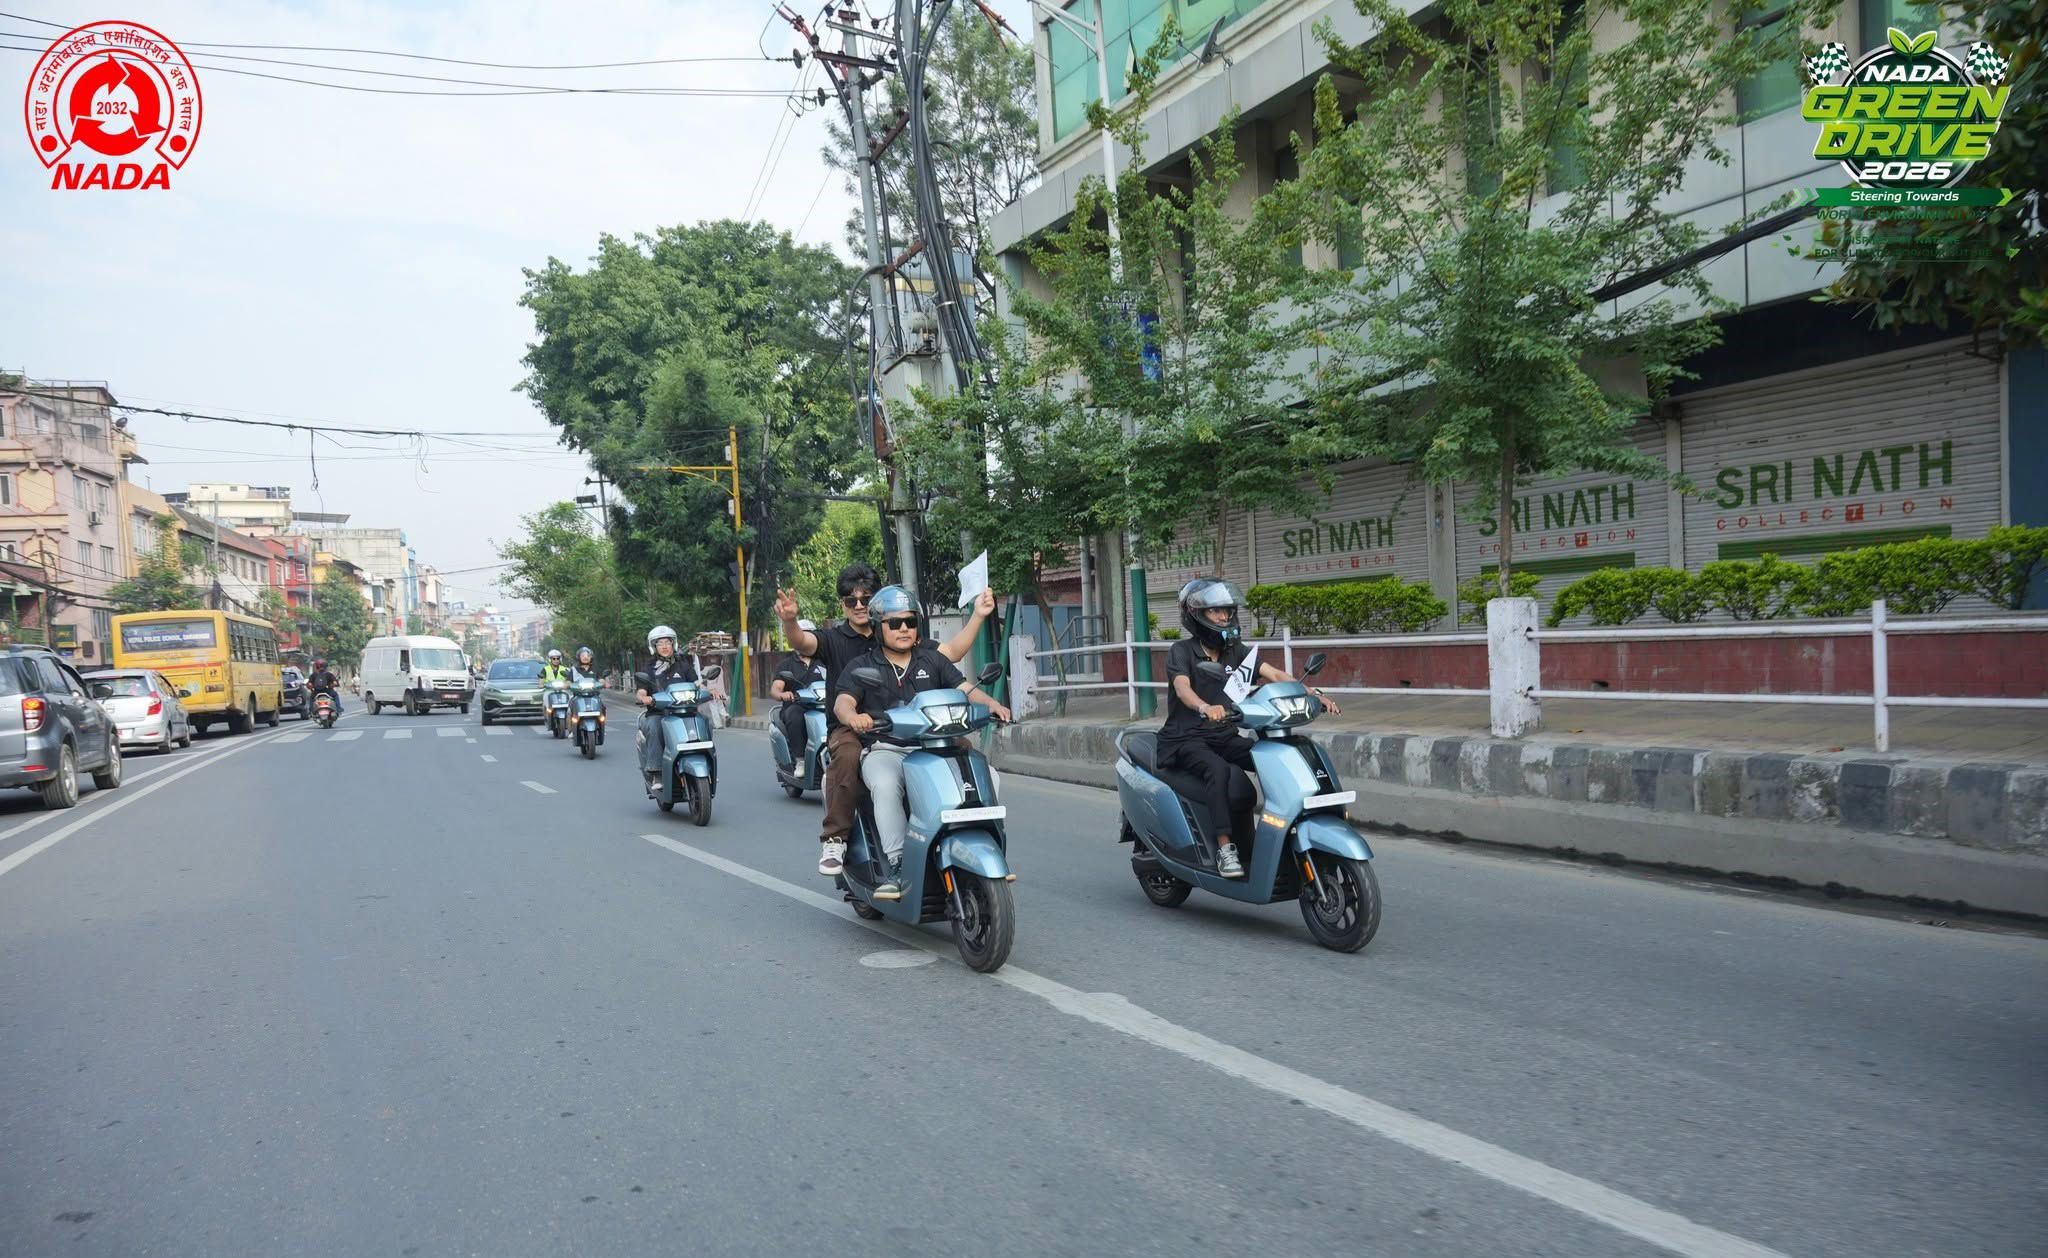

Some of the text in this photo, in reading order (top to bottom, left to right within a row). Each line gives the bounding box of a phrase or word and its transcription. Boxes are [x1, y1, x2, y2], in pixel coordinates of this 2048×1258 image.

[1716, 440, 1953, 509] SRI NATH
[1543, 483, 1635, 530] NATH
[1716, 496, 1953, 530] COLLECTION
[1282, 517, 1394, 558] SRI NATH
[1479, 529, 1635, 555] COLECTION
